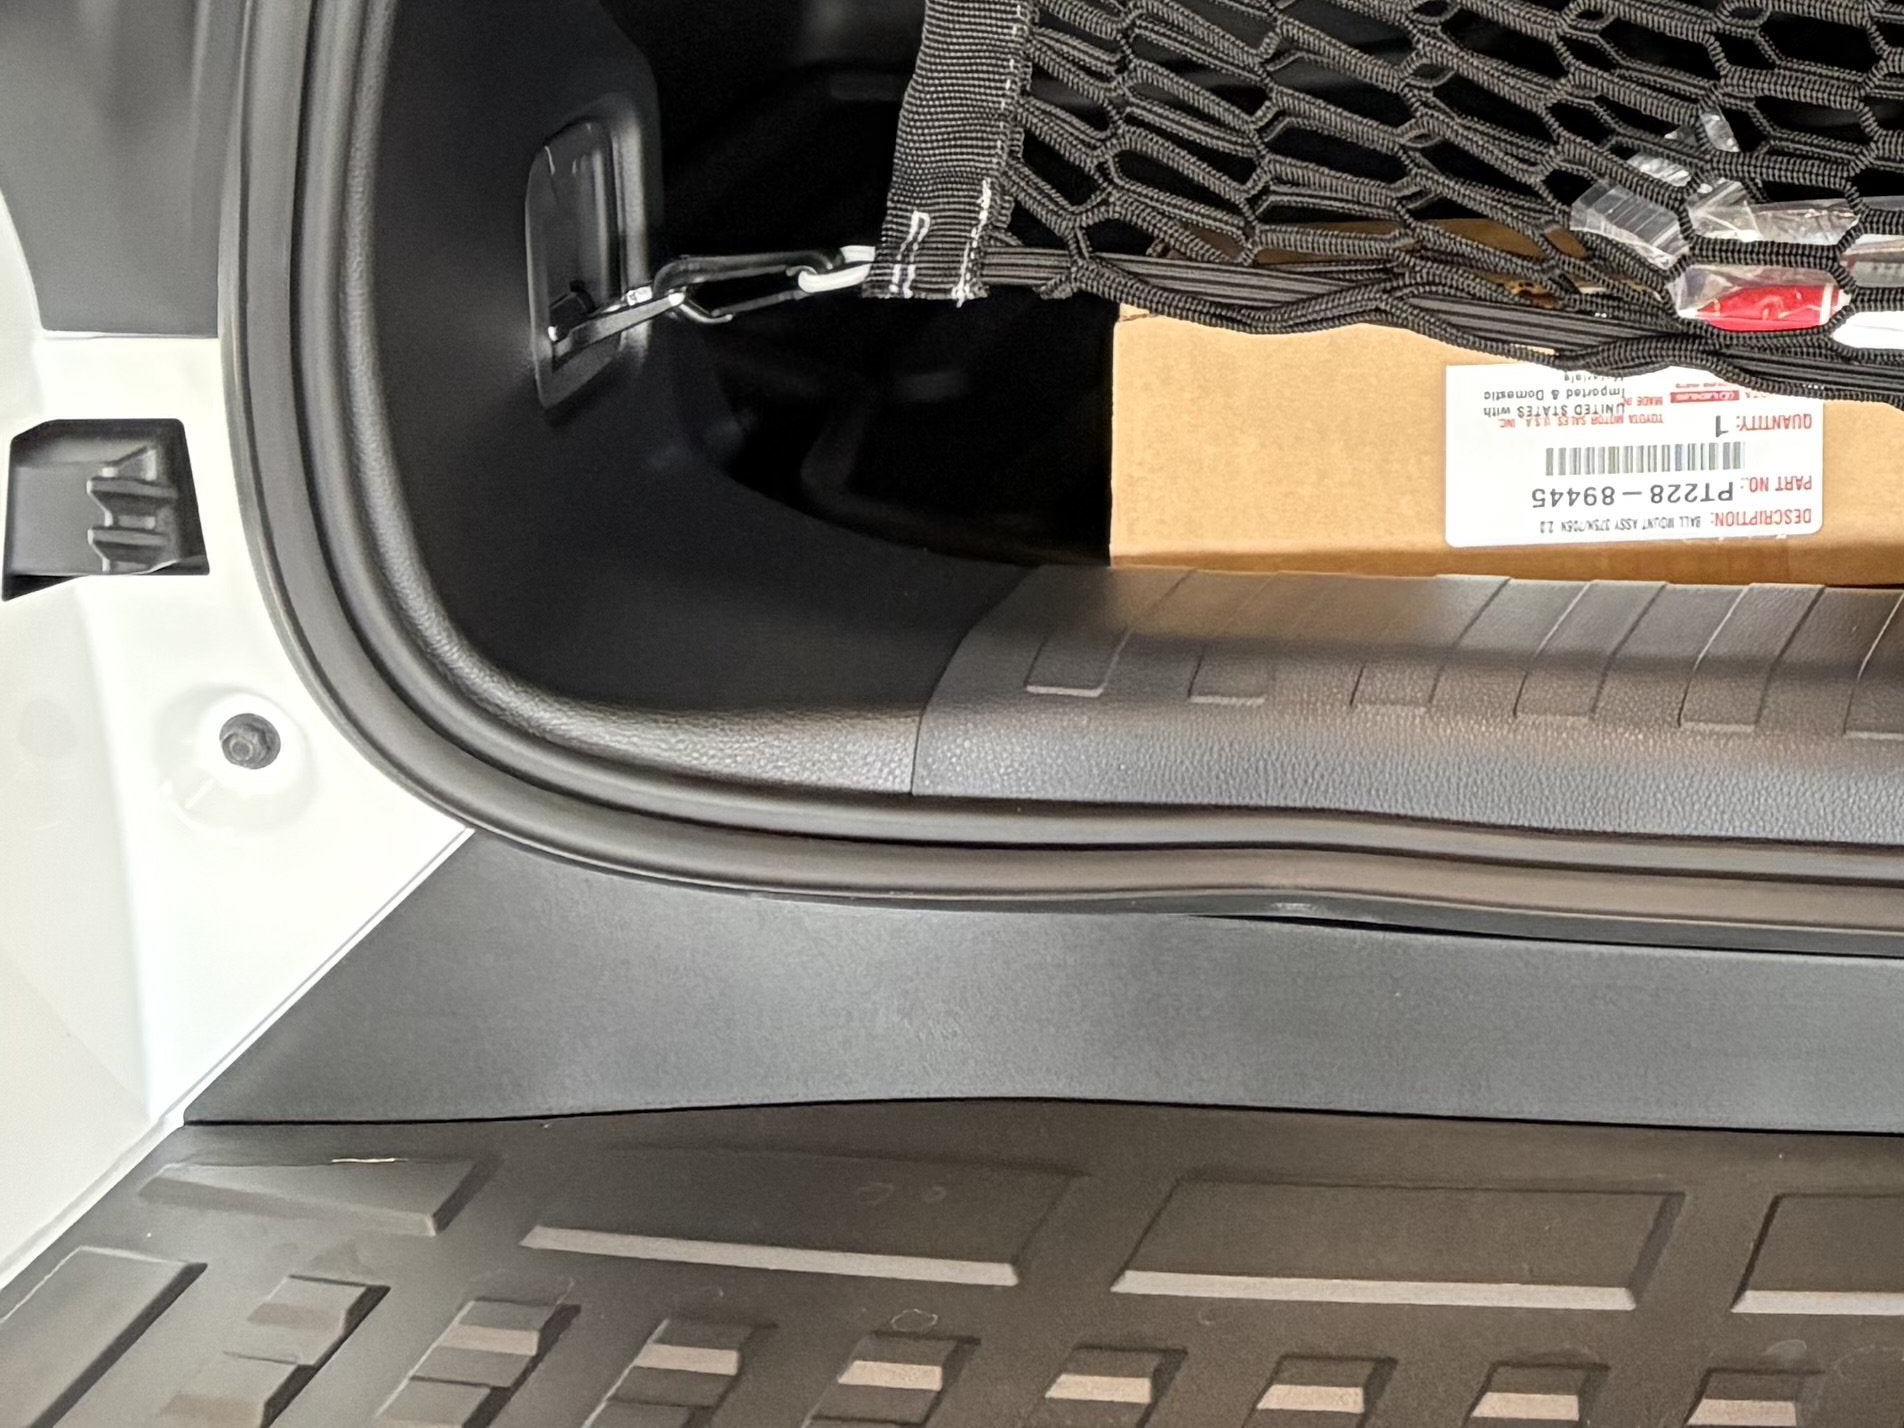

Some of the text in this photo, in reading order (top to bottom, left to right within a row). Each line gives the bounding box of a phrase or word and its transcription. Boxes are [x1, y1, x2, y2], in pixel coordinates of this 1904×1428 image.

[1483, 390, 1544, 402] Domestic
[1566, 387, 1626, 401] Imported
[1483, 402, 1626, 419] UNITED STATES with
[1715, 413, 1813, 438] QUANTITY: 1
[1776, 475, 1813, 491] PART
[1710, 508, 1813, 527] DESCRIPTION:
